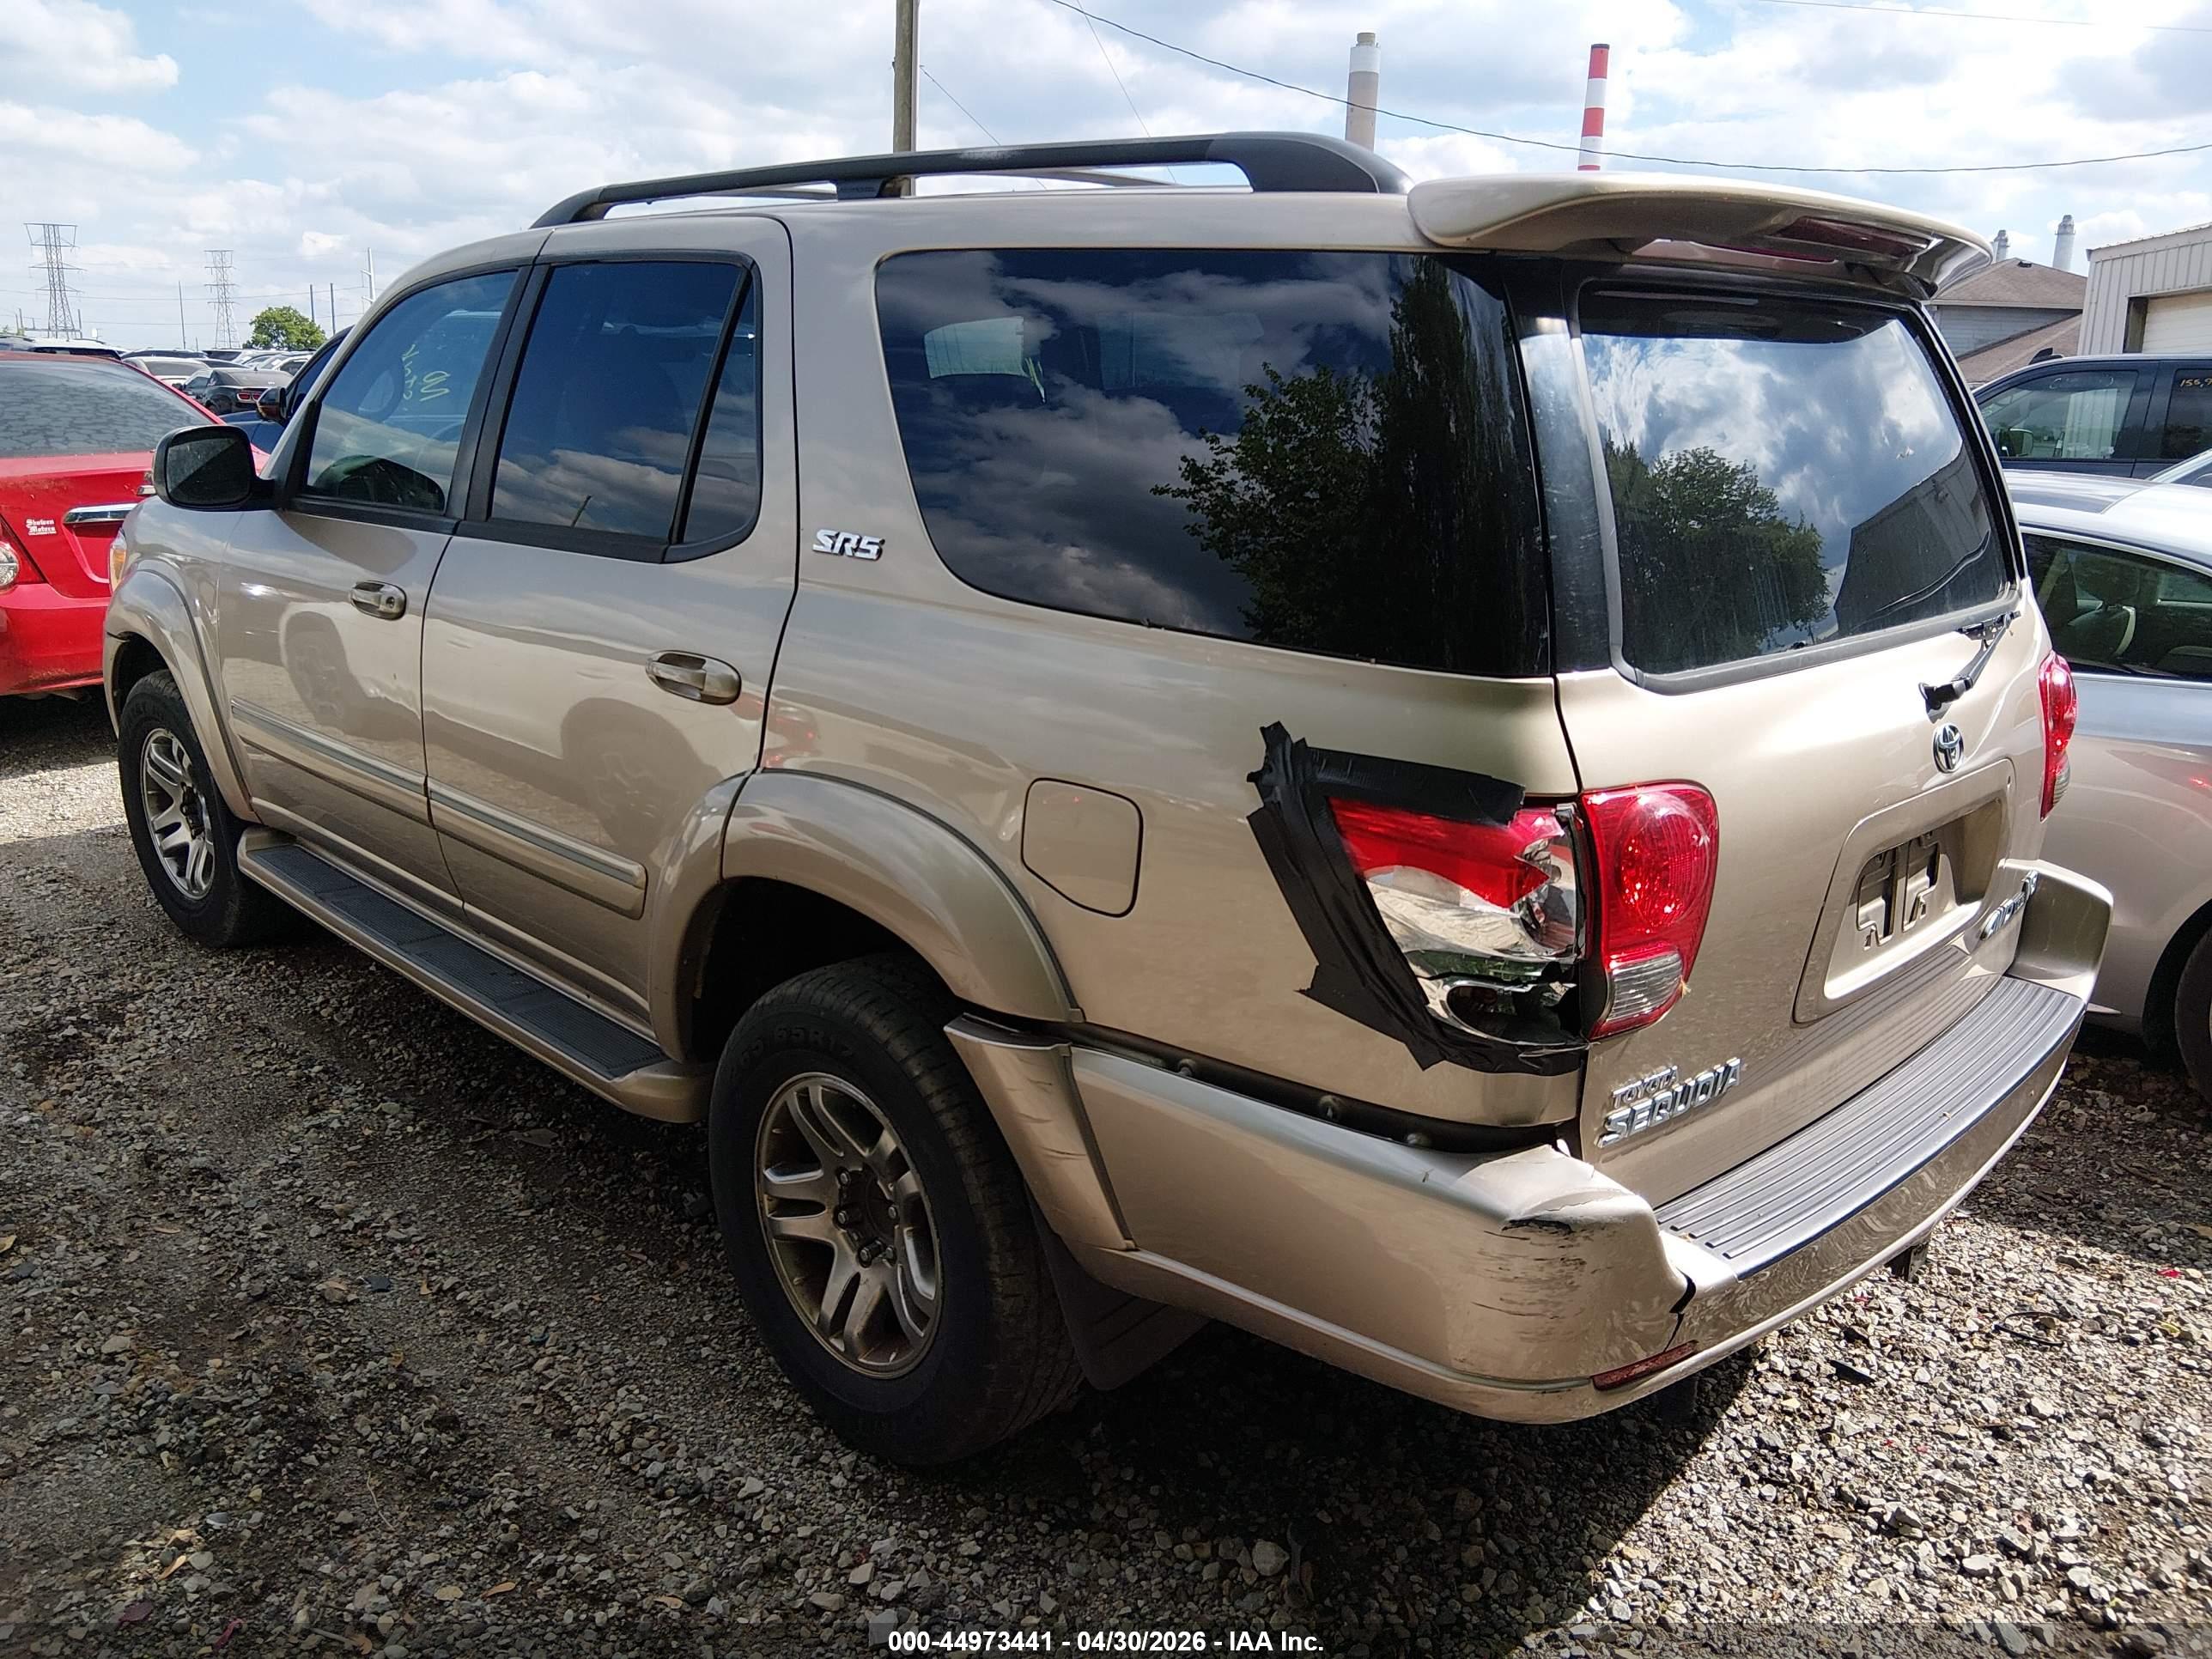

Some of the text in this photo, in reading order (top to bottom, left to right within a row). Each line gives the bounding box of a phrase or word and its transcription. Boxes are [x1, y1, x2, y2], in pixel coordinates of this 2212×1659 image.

[812, 529, 885, 561] SR5
[1595, 1057, 1742, 1148] SEQUOIA
[1611, 1065, 1680, 1108] TOYOTA
